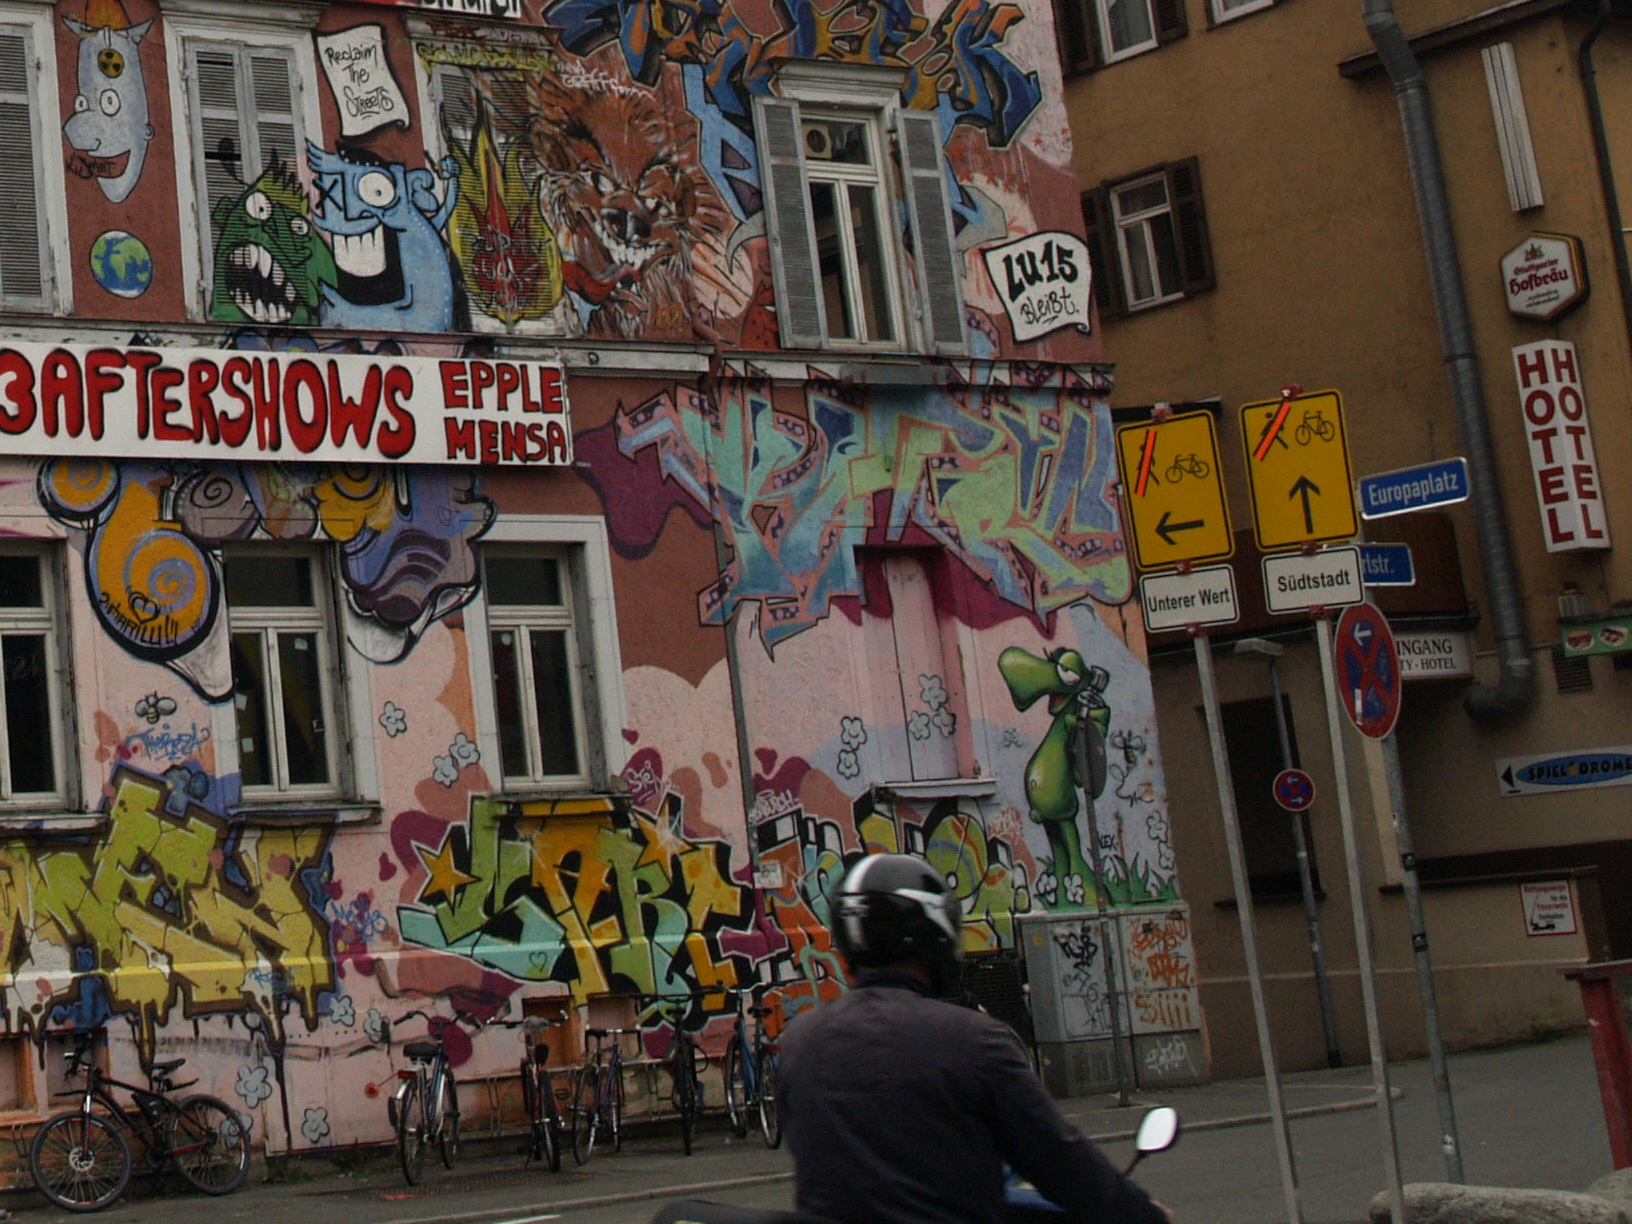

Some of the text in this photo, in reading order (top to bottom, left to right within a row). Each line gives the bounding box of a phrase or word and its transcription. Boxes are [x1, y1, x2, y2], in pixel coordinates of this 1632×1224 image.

[342, 62, 370, 88] The
[1509, 265, 1569, 295] Hofbräu
[438, 359, 565, 415] EPPLE
[442, 415, 567, 466] MENSA
[1517, 349, 1576, 544] HOTEL
[1550, 348, 1604, 539] HOTEL
[1369, 470, 1460, 507] Europaplatz
[1361, 552, 1395, 574] rlstr.
[1277, 571, 1351, 594] Südtstadt
[1148, 587, 1231, 614] Unterer Wert
[1396, 637, 1453, 656] INGANG
